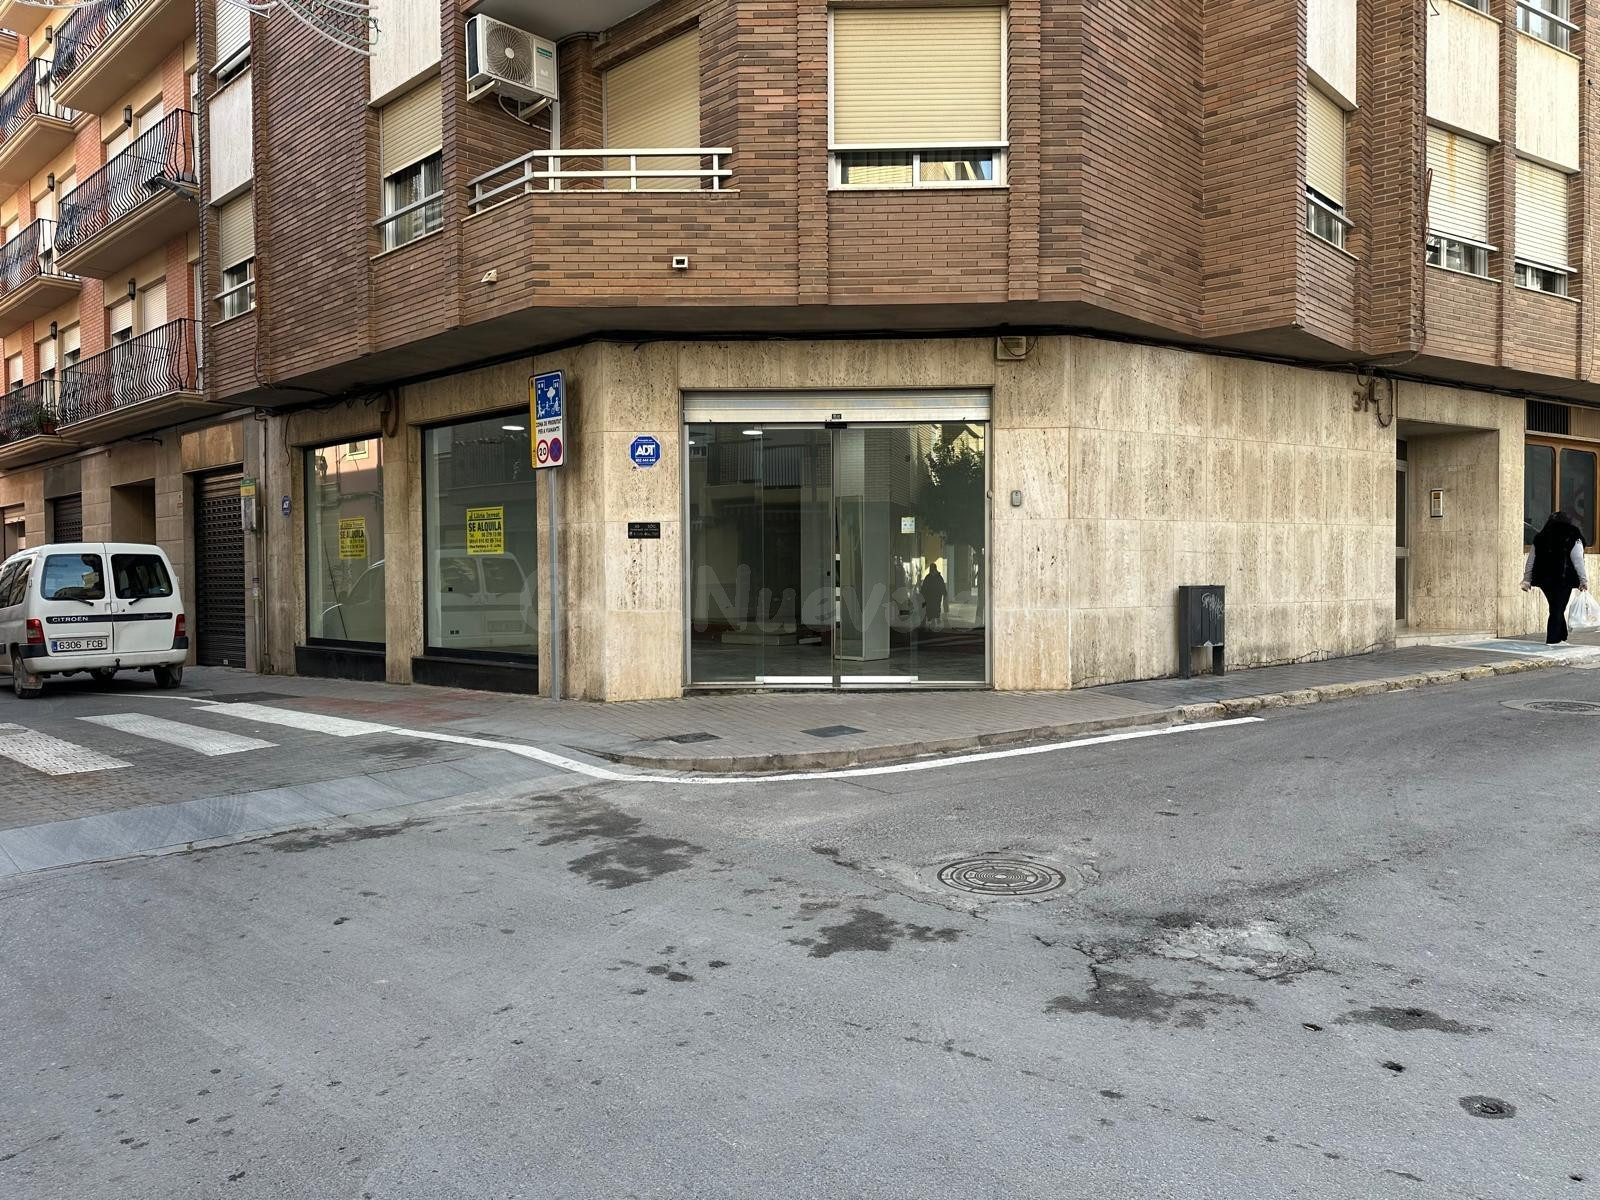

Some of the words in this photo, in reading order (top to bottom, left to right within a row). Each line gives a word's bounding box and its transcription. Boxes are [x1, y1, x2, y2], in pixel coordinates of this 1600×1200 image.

[539, 447, 547, 456] 20
[635, 445, 655, 456] ADT
[468, 522, 476, 532] SE
[478, 521, 502, 532] ALQUILA
[340, 530, 346, 539] SE
[59, 641, 82, 650] 6306
[86, 640, 103, 649] FCB
